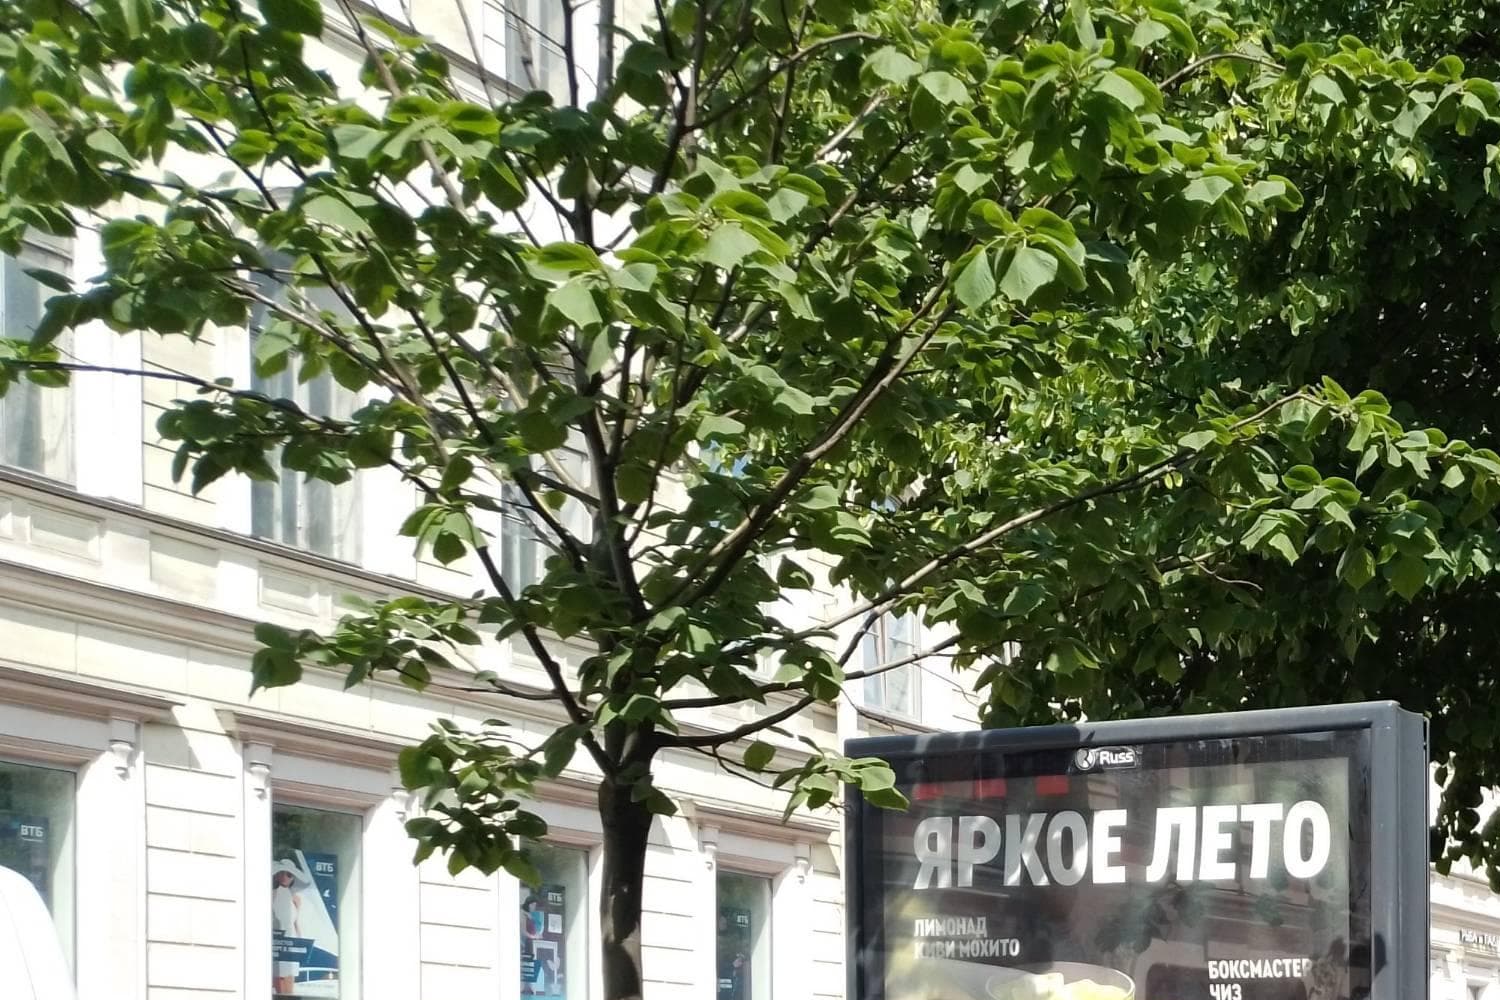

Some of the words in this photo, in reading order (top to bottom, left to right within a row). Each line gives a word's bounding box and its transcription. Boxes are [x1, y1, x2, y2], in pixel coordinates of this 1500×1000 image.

[21, 824, 44, 837] ВТБ
[913, 808, 1127, 890] ЯРКОЕ
[1146, 800, 1331, 883] ЛЕТО
[315, 862, 334, 873] ВТБ
[914, 916, 988, 938] ЛИМОНАД
[914, 940, 956, 960] КИВИ
[960, 938, 1020, 958] МОХИТО
[1208, 958, 1313, 979] БОКСМАСТЕР
